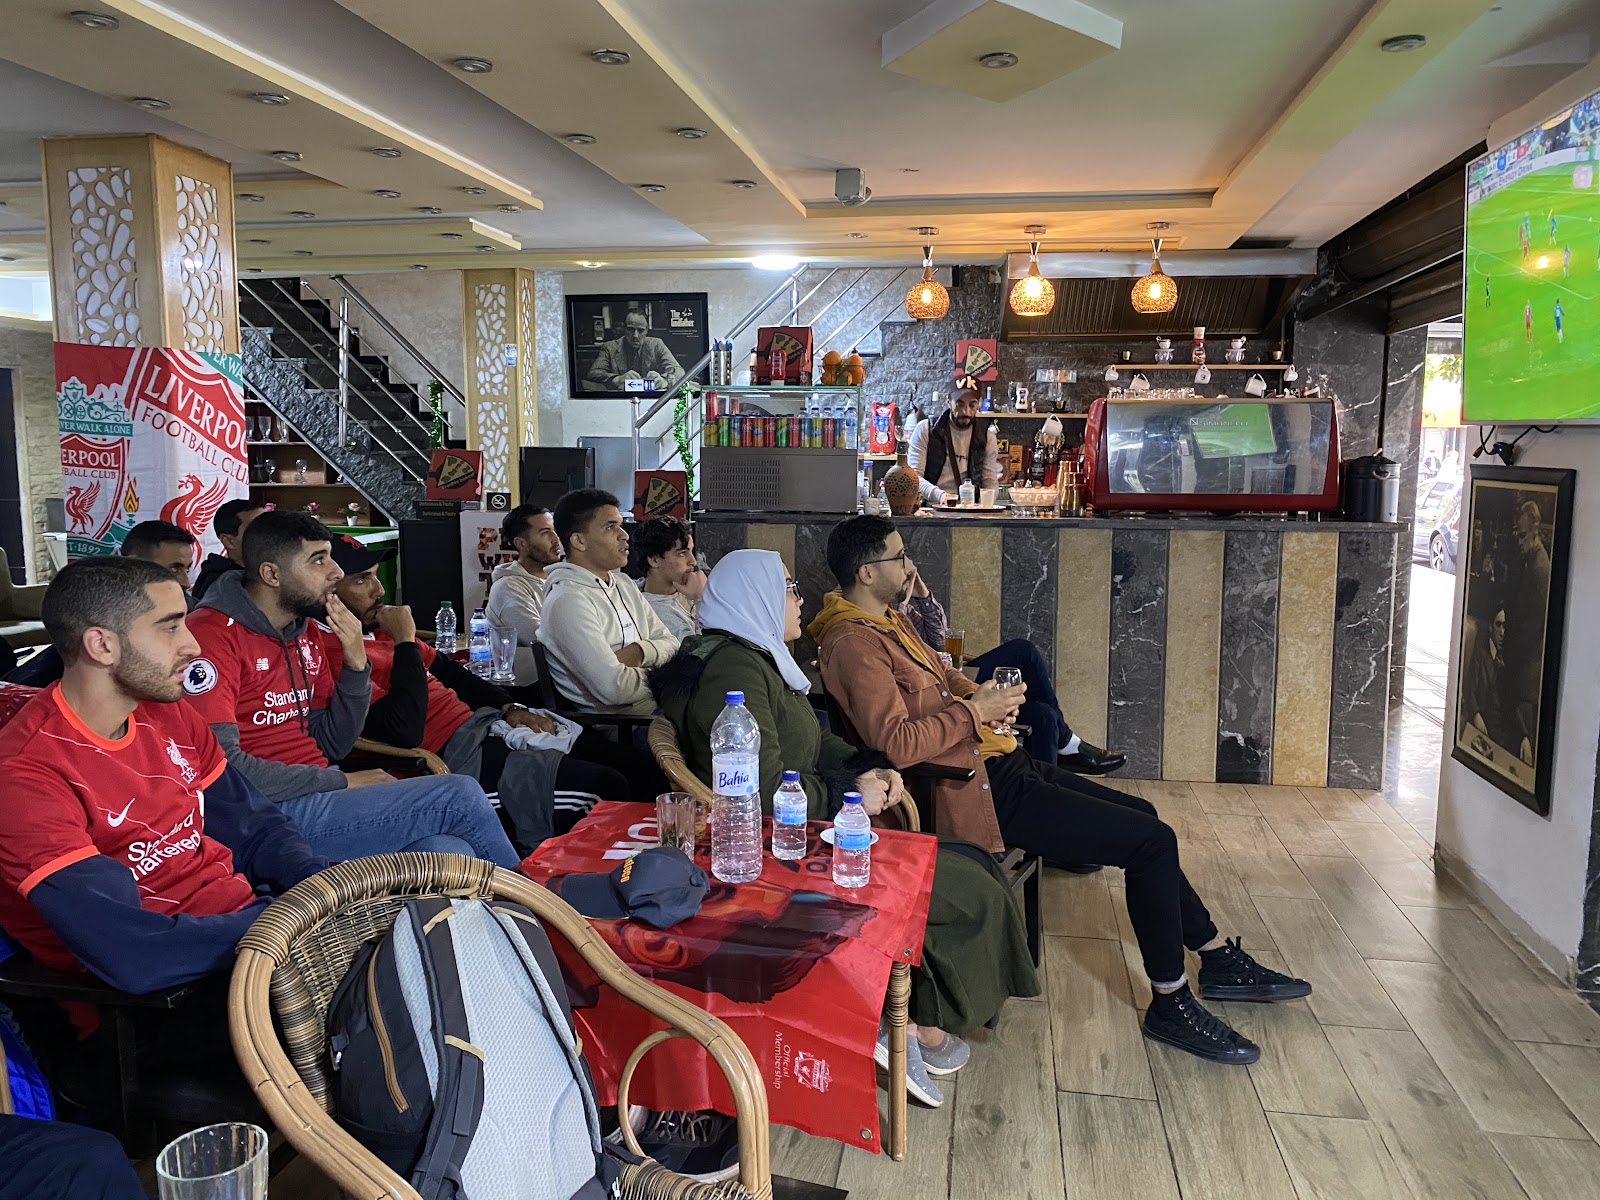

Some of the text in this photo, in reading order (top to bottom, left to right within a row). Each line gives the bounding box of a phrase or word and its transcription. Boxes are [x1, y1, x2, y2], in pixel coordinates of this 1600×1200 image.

[75, 422, 102, 433] WALK
[104, 424, 131, 435] ALONE
[141, 406, 218, 467] FOOTBALL
[91, 469, 116, 480] CLUB
[719, 770, 750, 788] Bahia
[773, 1030, 783, 1089] Membership
[783, 1044, 791, 1078] Official
